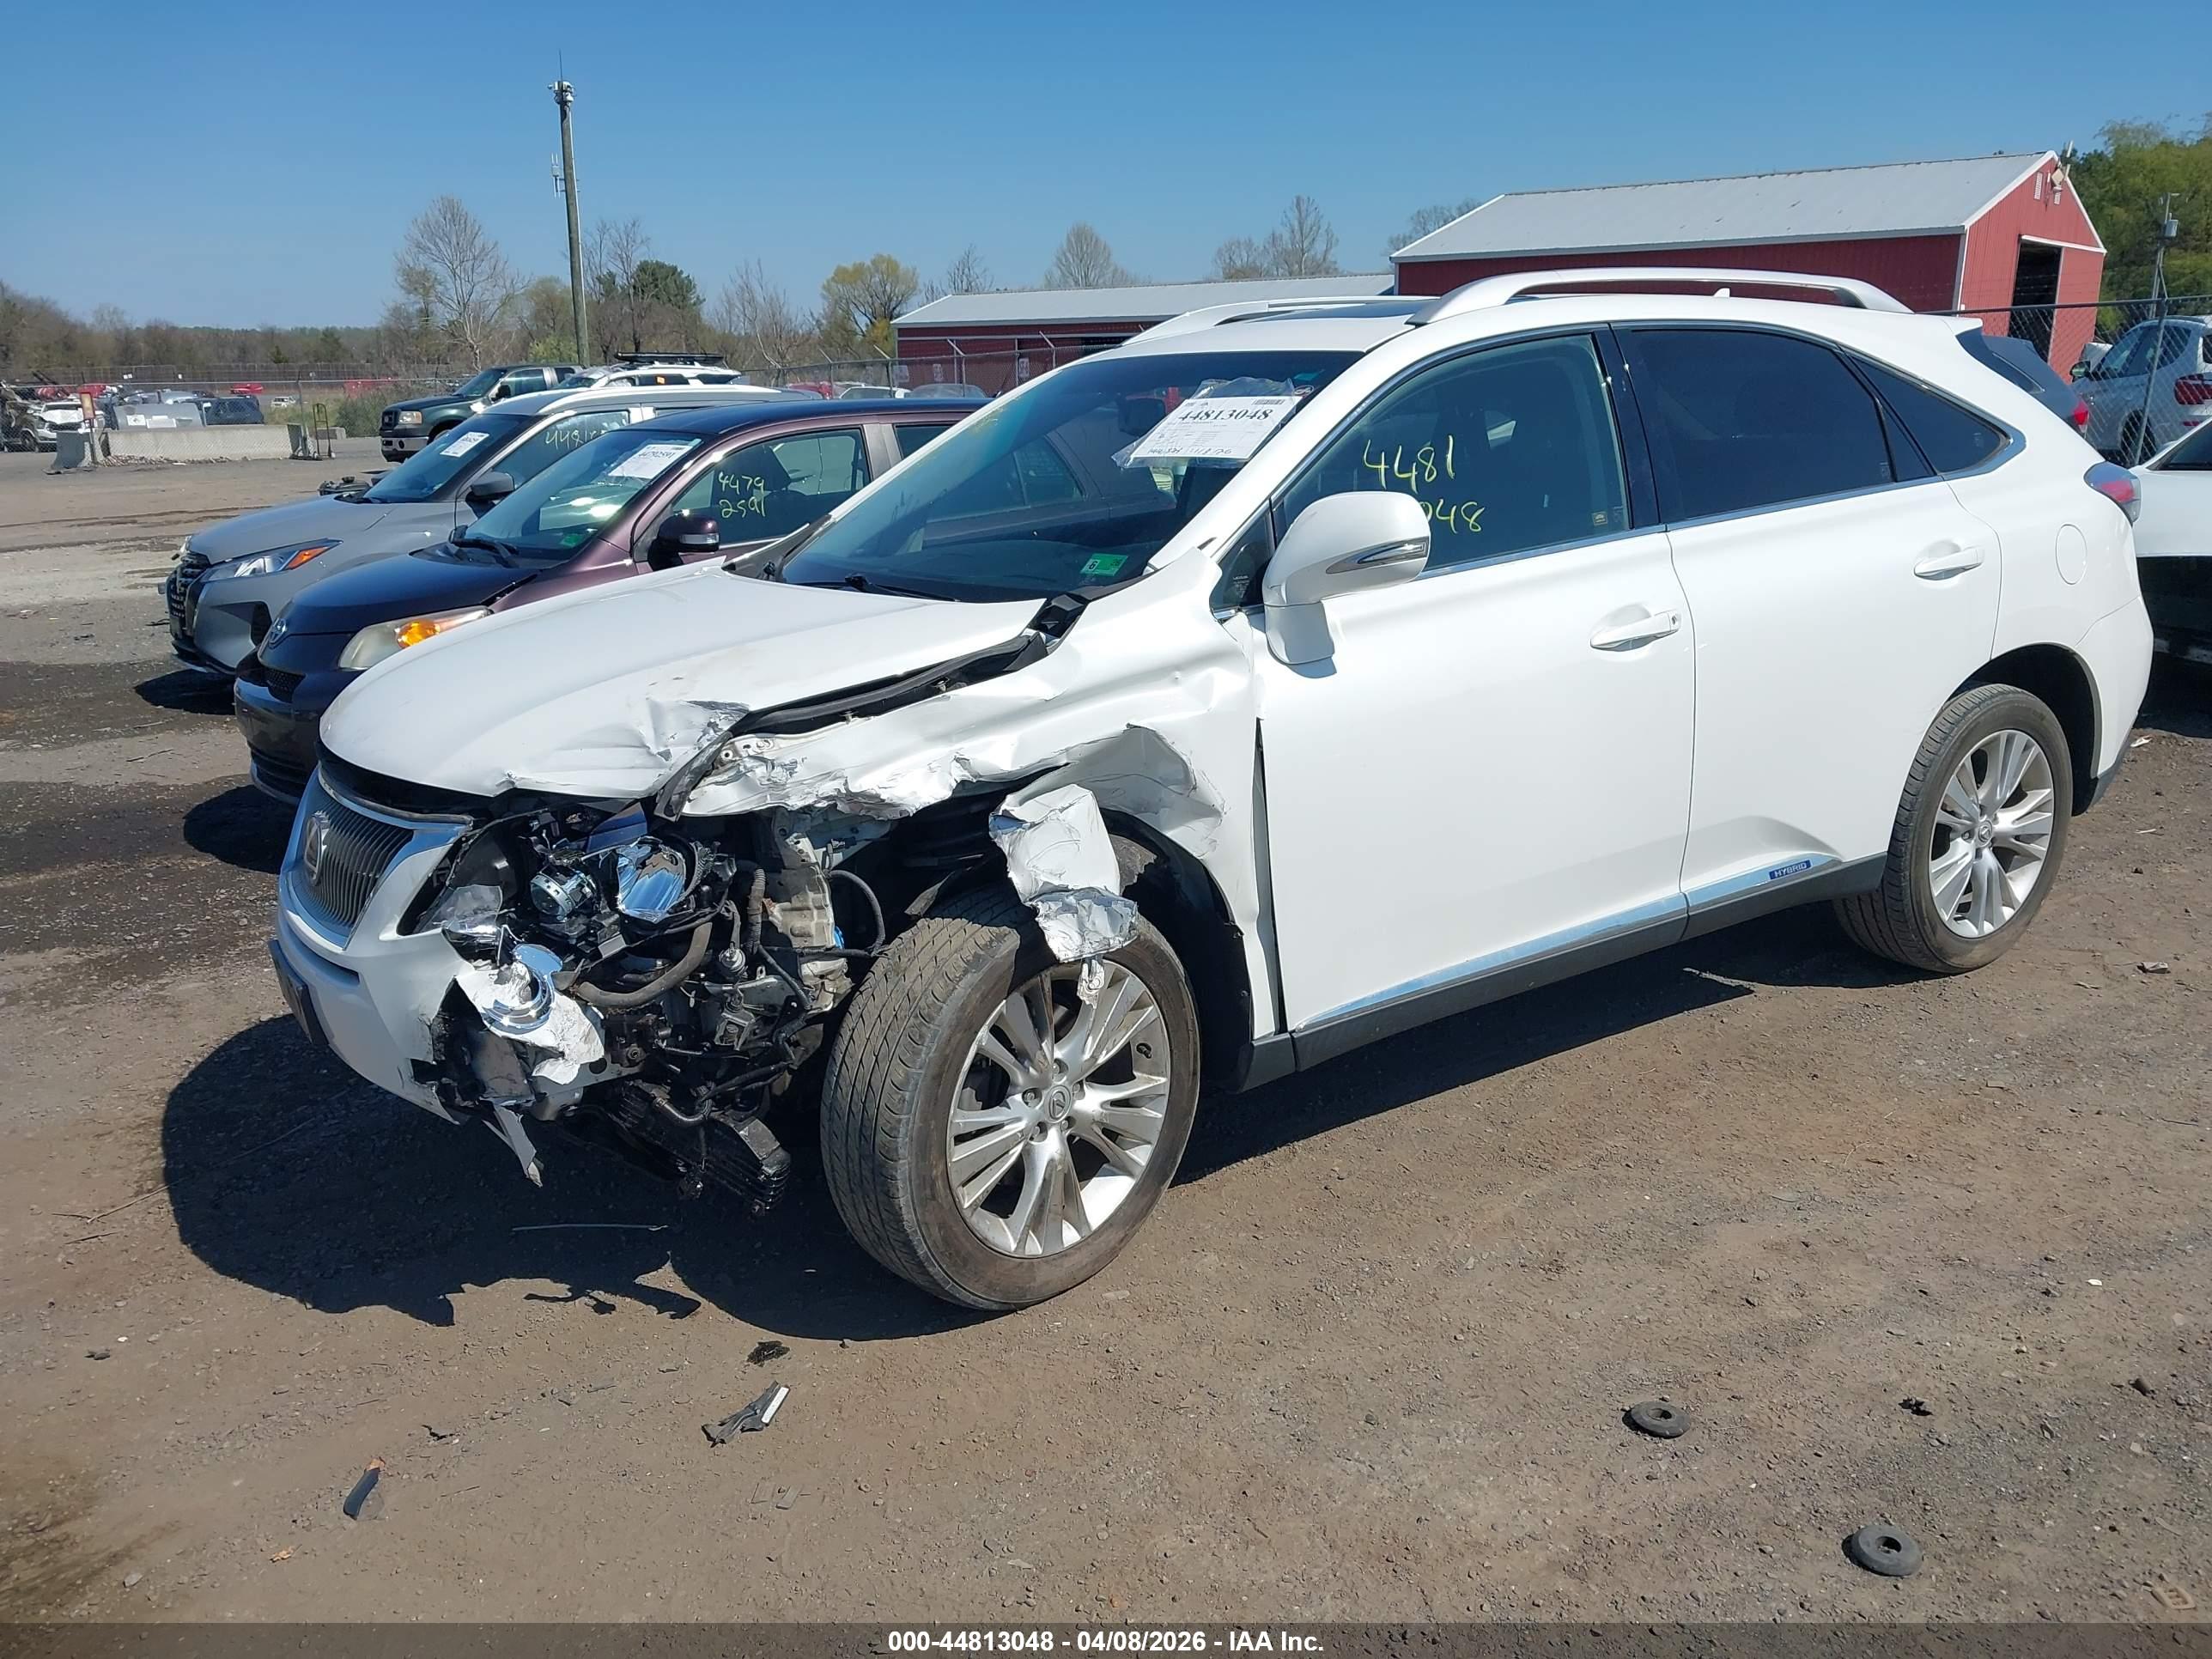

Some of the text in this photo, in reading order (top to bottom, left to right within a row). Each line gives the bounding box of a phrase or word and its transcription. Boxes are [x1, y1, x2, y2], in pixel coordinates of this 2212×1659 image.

[1178, 409, 1273, 421] 44813048
[1364, 434, 1455, 495] 4481
[718, 471, 764, 495] 4479
[719, 495, 766, 519] 2591
[1774, 862, 1808, 878] HYBRID
